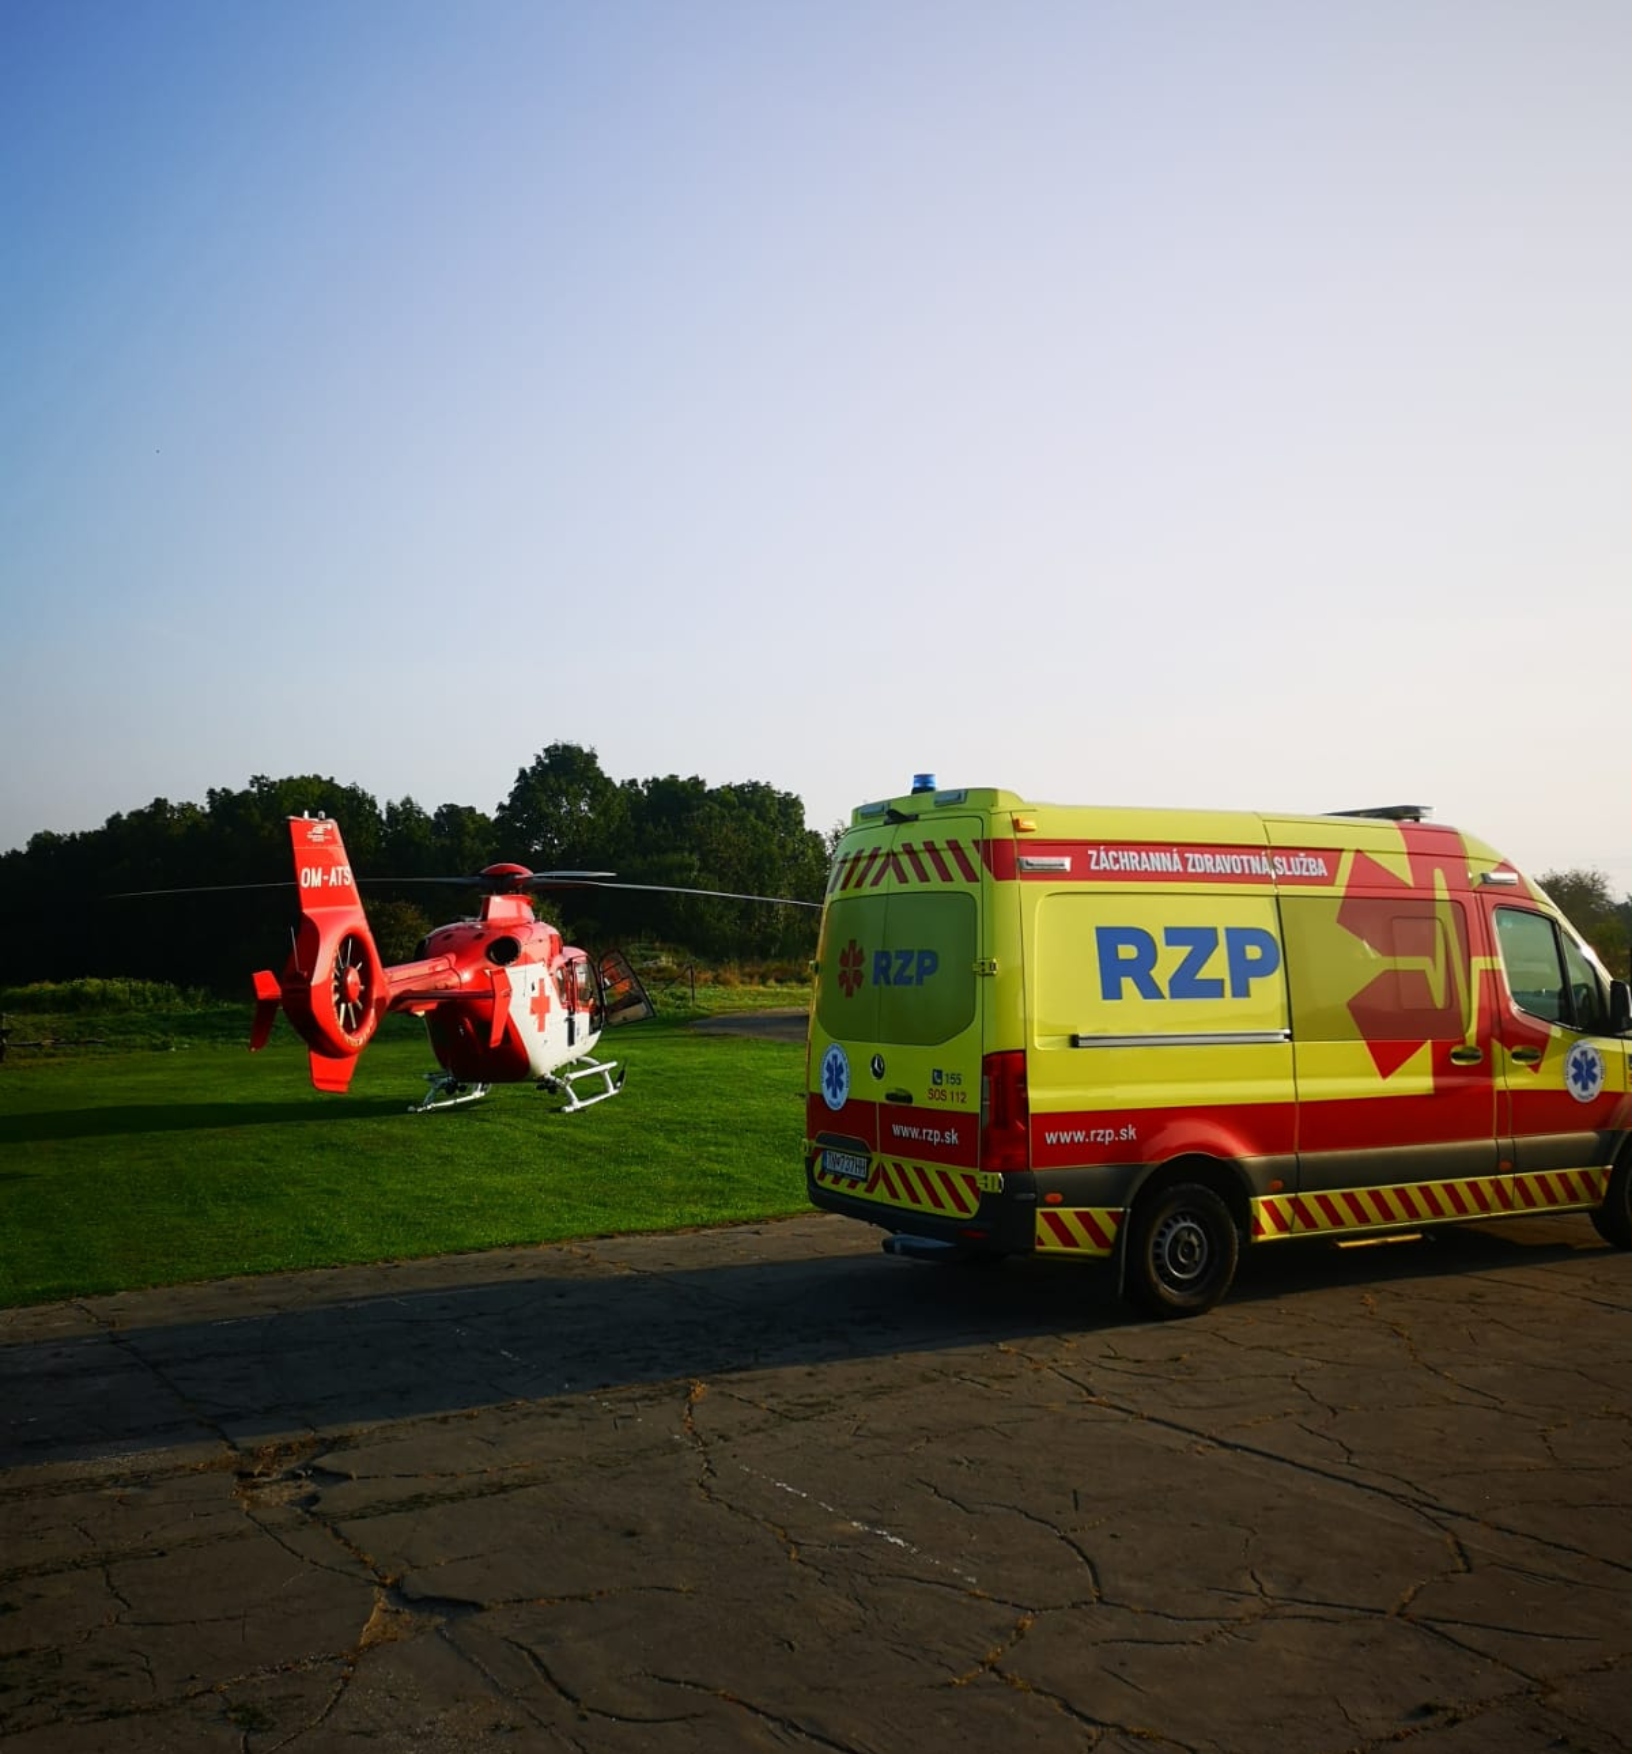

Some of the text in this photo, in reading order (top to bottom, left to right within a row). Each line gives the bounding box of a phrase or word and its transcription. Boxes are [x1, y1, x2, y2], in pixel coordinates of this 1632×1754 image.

[1088, 846, 1328, 877] ZÁCHRANNÁ ZDRAVOTNÁ SLUŽBA
[301, 865, 352, 888] OM-ATS
[872, 949, 939, 987] RZP
[1095, 925, 1281, 1001] RZP
[945, 1073, 962, 1086] 155
[928, 1088, 967, 1104] SOS 112
[892, 1124, 959, 1145] www.rzp.sk
[1044, 1123, 1137, 1146] www.rzp.sk
